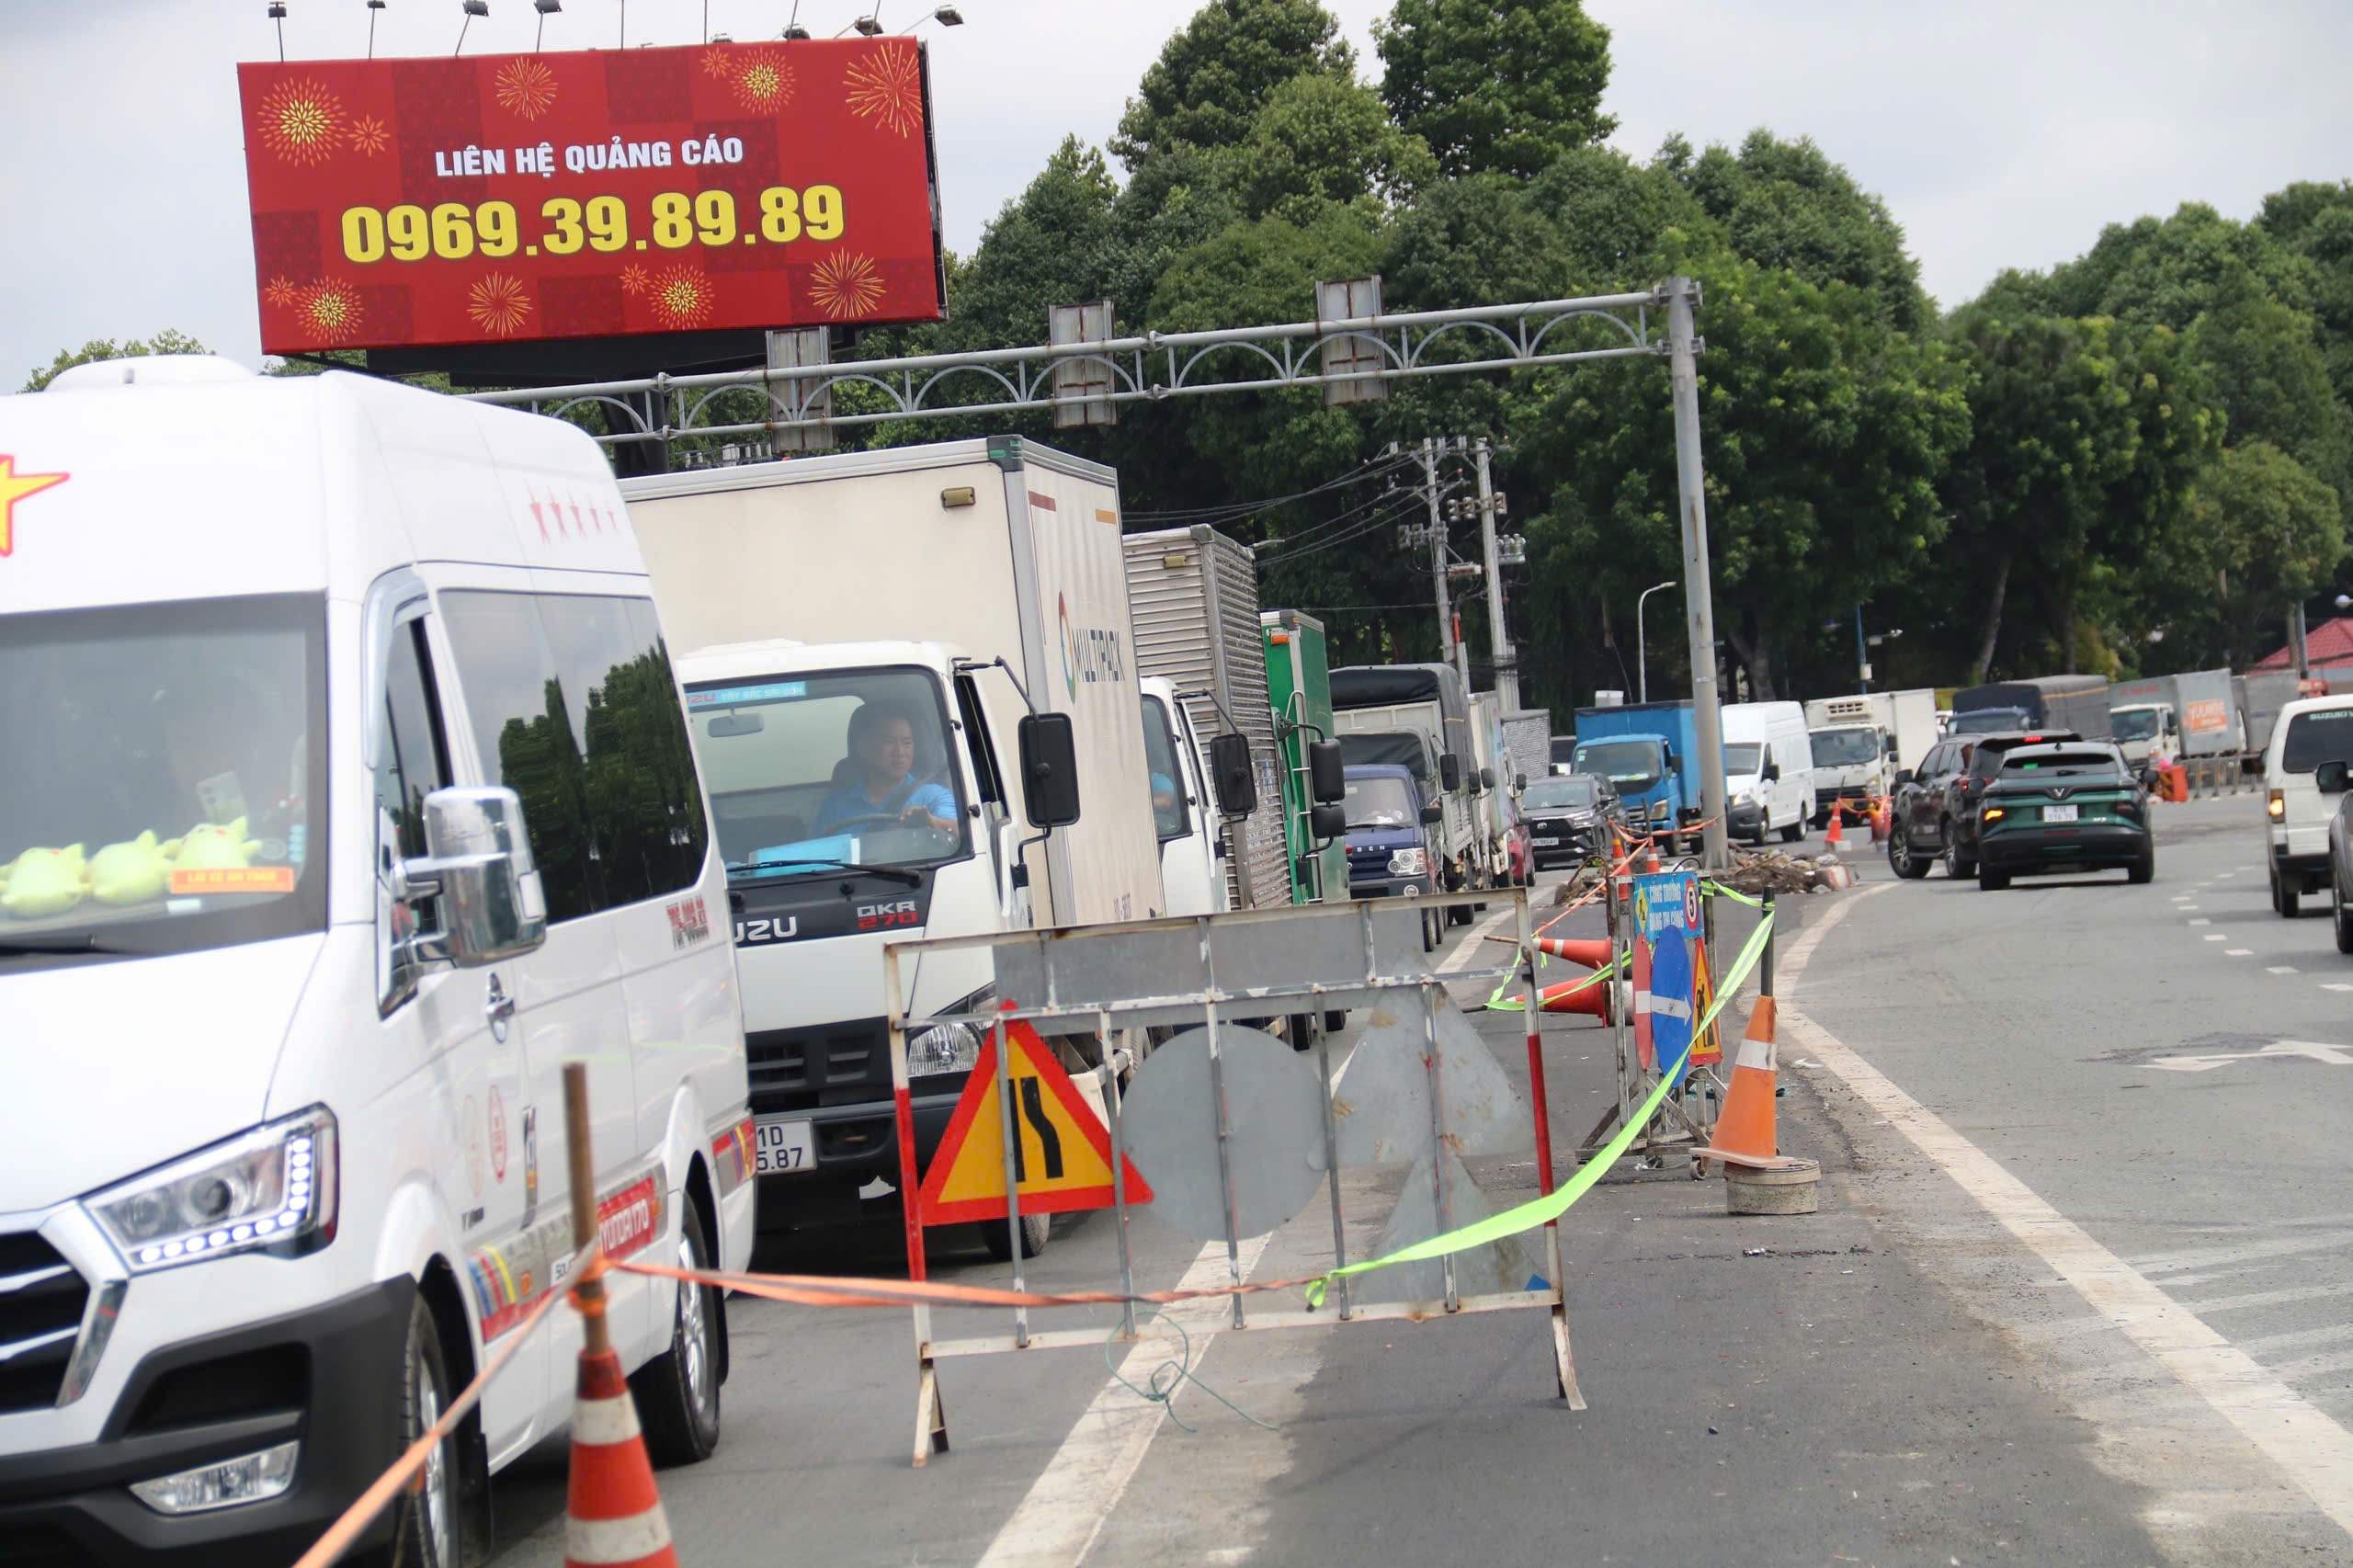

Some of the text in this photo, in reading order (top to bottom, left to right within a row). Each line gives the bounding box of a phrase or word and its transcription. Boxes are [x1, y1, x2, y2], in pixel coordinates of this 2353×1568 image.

[435, 133, 744, 178] LIÊN HỆ QUẢNG CÁO
[341, 185, 845, 263] 0969.39.89.89
[1071, 629, 1126, 682] MULTIPACK
[857, 901, 916, 918] QKR
[858, 912, 918, 929] 270
[1688, 891, 1695, 917] 5
